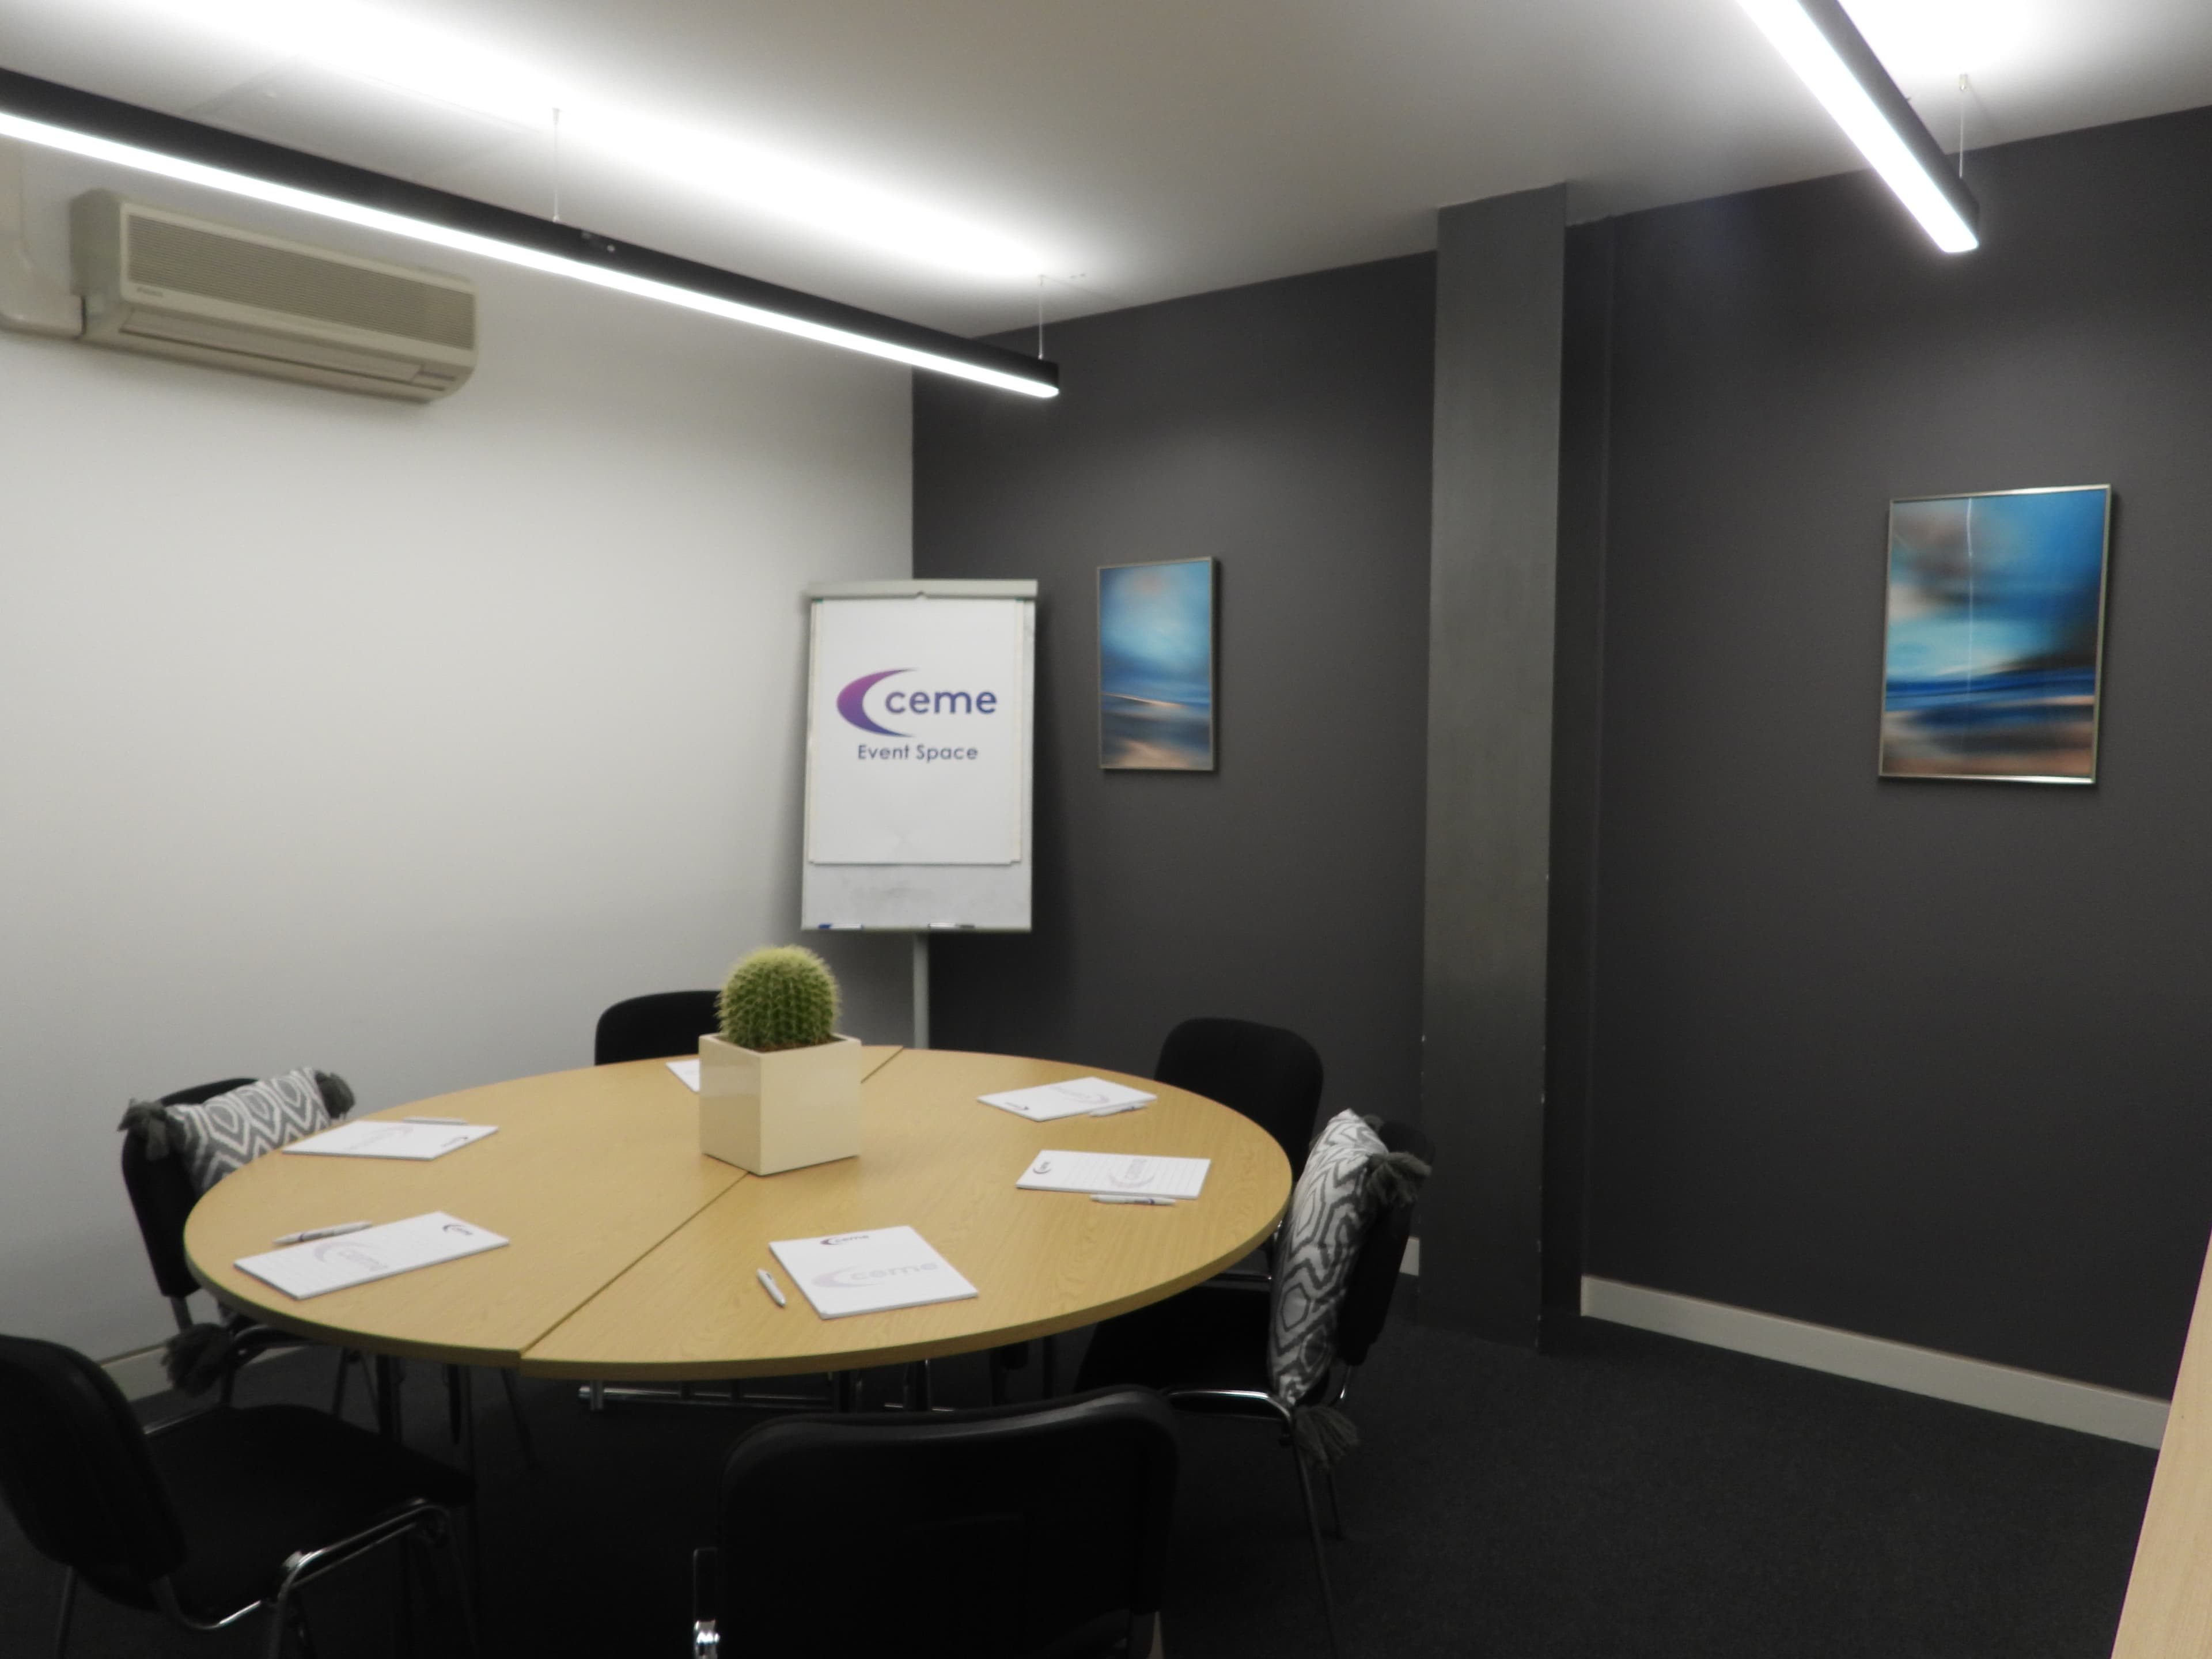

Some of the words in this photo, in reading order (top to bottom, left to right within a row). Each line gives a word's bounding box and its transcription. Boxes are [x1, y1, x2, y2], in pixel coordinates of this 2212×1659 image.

[885, 691, 997, 714] ceme
[858, 744, 910, 760] Event
[916, 744, 979, 763] Space
